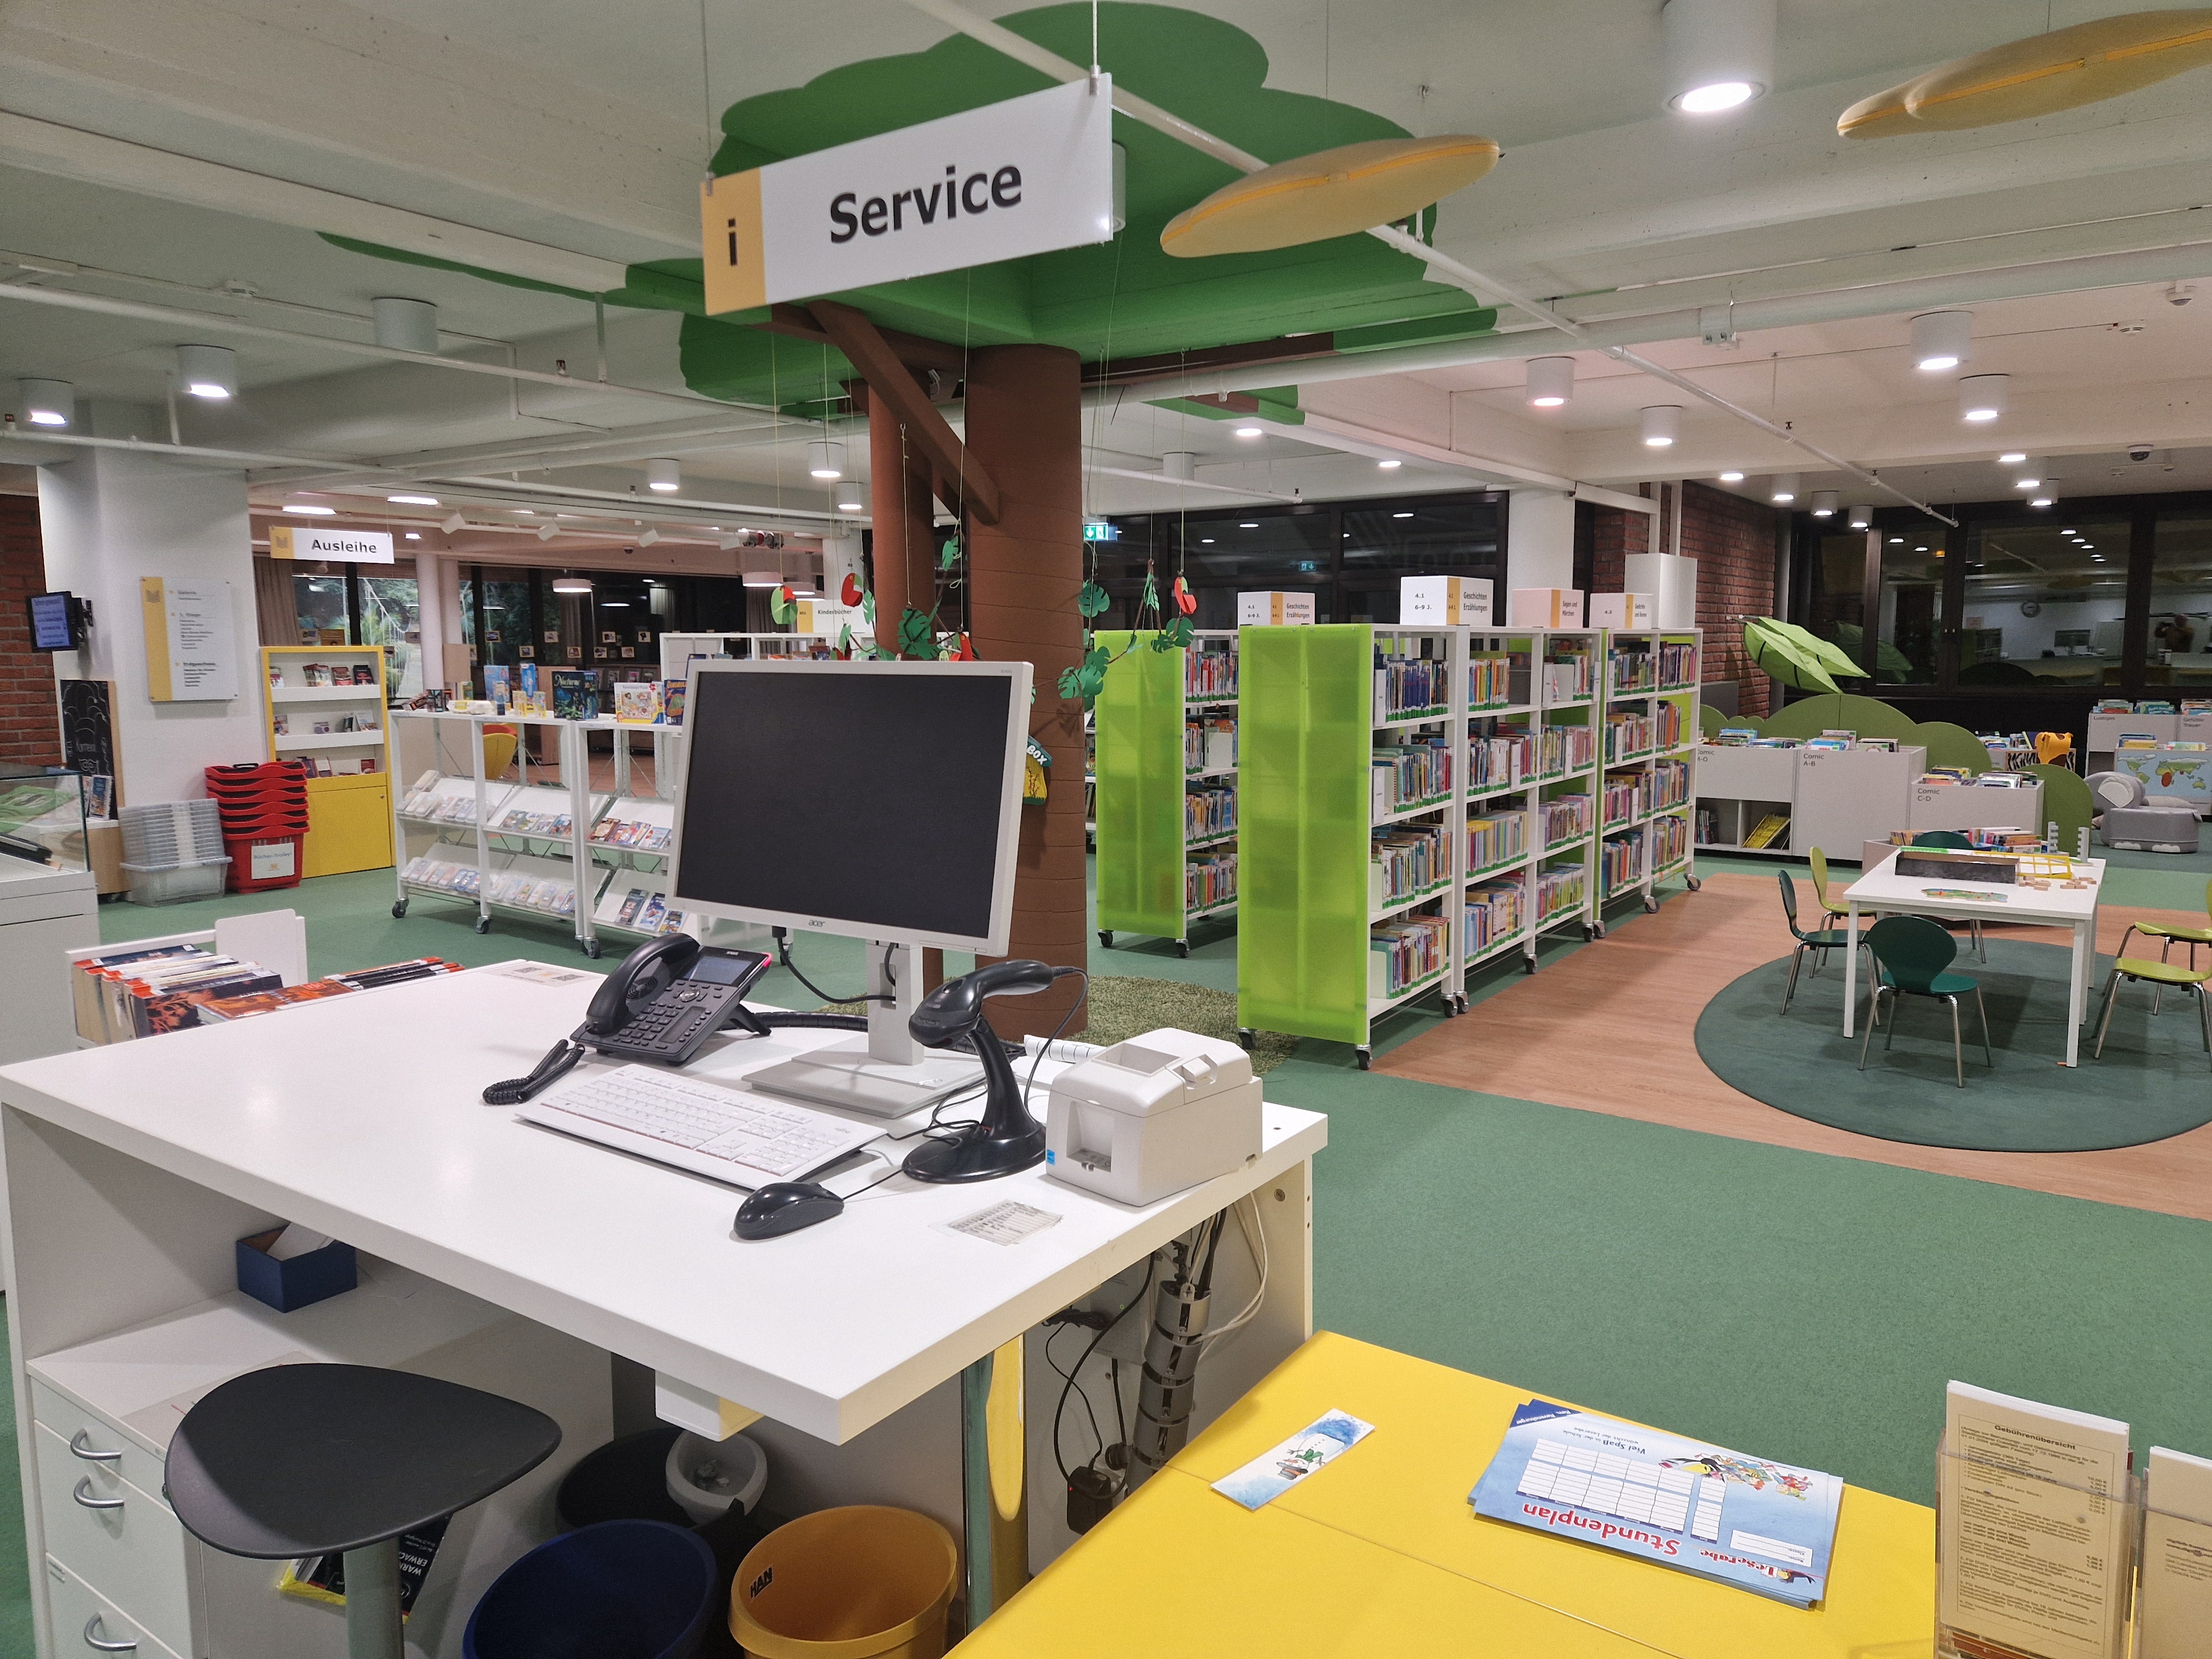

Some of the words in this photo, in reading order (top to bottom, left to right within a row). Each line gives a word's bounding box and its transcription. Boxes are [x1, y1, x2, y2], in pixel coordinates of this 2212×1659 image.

[728, 217, 738, 266] i
[830, 165, 1022, 244] Service
[311, 539, 377, 554] Ausleihe
[1463, 592, 1488, 600] Geschichten
[1463, 603, 1488, 613] Erzählungen
[1026, 745, 1047, 765] BOX
[1516, 1413, 1556, 1425] Ravensburger
[1563, 1430, 1582, 1438] Schule
[1574, 1427, 1600, 1437] Leserabe
[1994, 1425, 2076, 1450] Gebührenübersicht
[1603, 1440, 1625, 1450] Spaß
[1613, 1436, 1639, 1445] wünscht
[1629, 1444, 1646, 1455] Viel
[1523, 1504, 1681, 1556] Stundenplan
[1700, 1550, 1775, 1577] Leserabe
[750, 1567, 773, 1599] HAN
